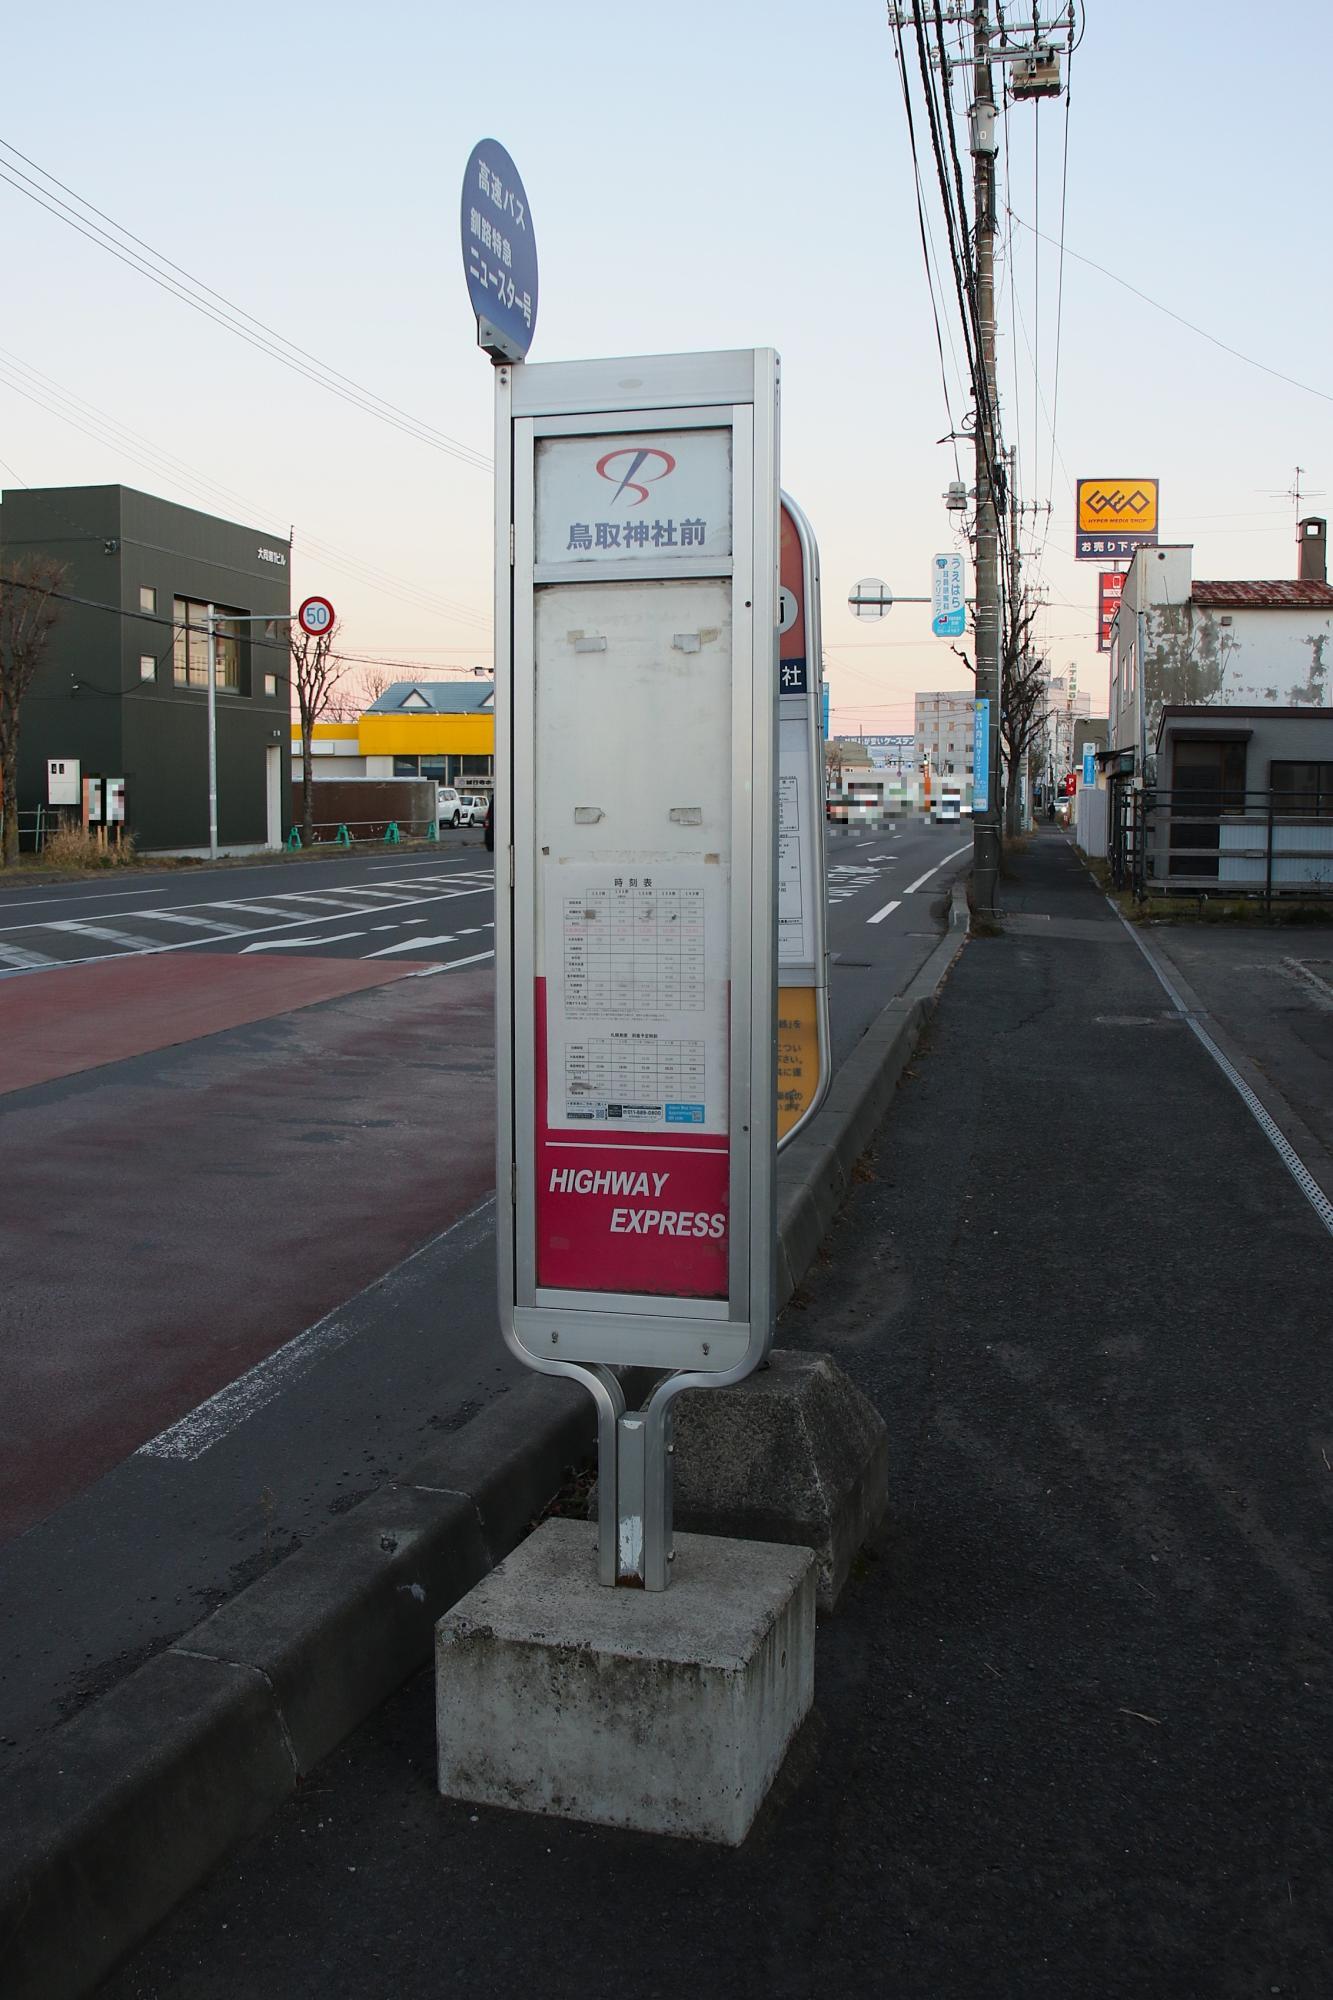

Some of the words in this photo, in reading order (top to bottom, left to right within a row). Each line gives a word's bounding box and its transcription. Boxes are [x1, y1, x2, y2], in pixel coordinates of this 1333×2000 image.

[478, 159, 526, 231] 高速バス
[470, 207, 512, 268] 釧路特急
[469, 247, 532, 329] ニュースター号
[1086, 490, 1150, 514] GEO
[566, 518, 707, 550] 鳥取神社前
[1081, 541, 1151, 552] お売り下さ
[951, 558, 960, 608] うえはら
[306, 607, 327, 625] 50
[614, 878, 653, 888] 時刻表
[549, 1168, 670, 1197] HIGHWAY
[610, 1208, 726, 1238] EXPRESS
